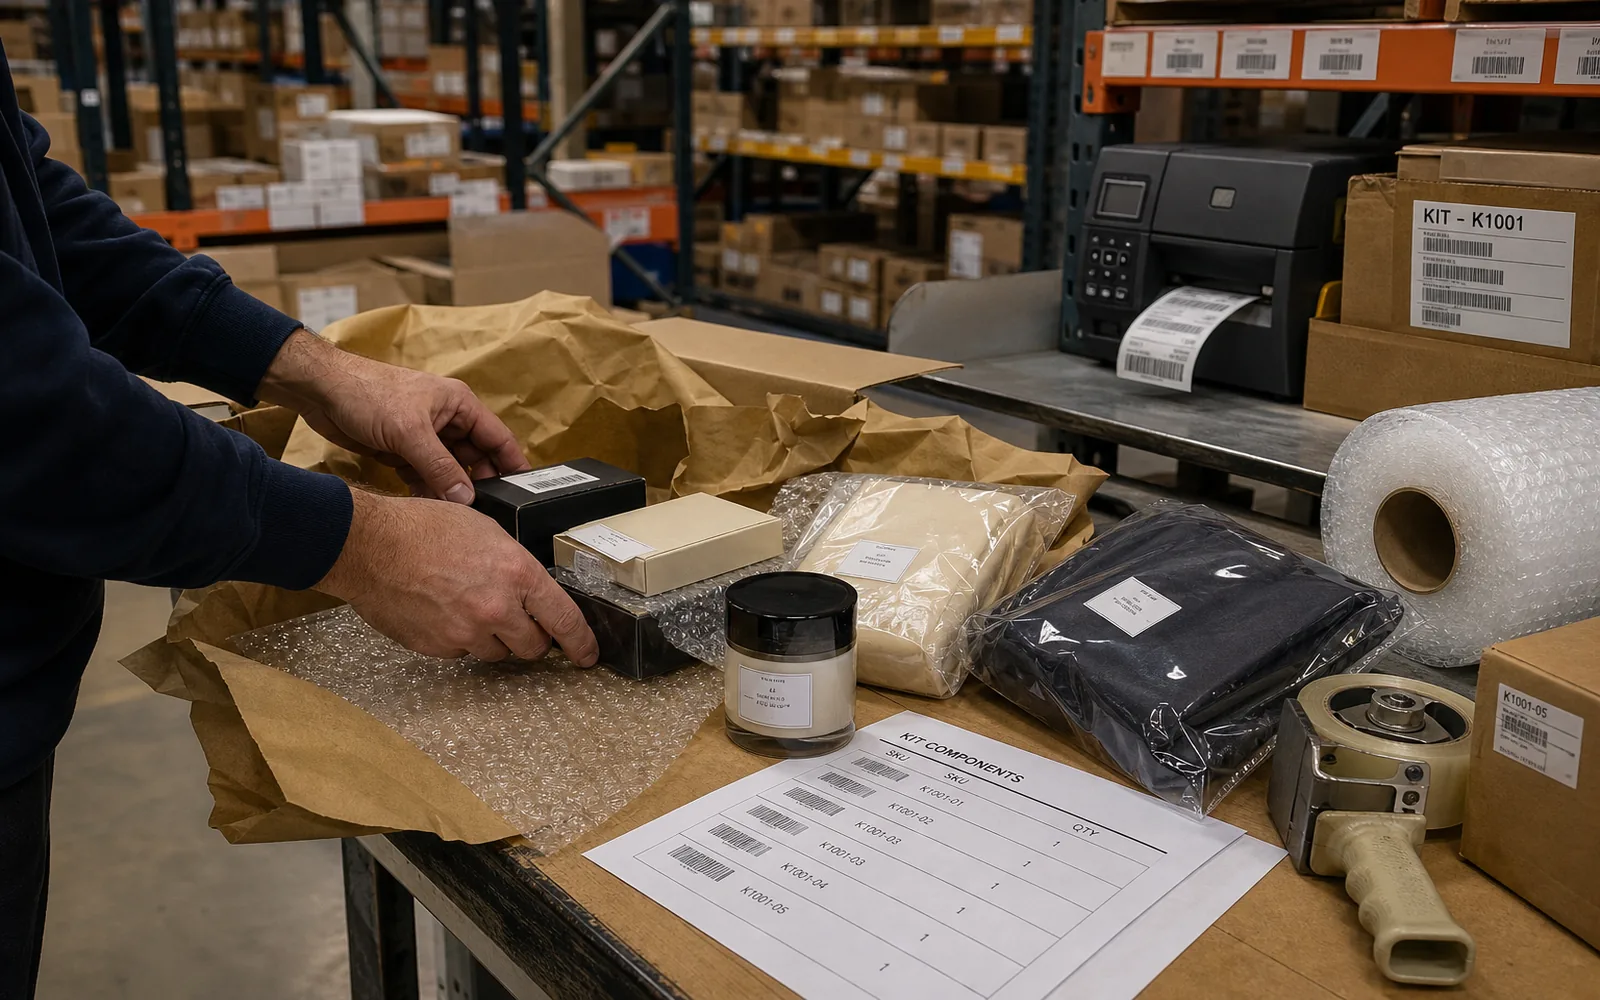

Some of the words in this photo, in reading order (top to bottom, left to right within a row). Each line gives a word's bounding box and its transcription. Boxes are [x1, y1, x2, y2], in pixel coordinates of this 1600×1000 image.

[1423, 208, 1451, 225] KIT
[1472, 211, 1523, 231] K1001
[1503, 690, 1548, 718] K1001-05
[900, 732, 926, 745] KIT
[924, 742, 1025, 784] COMPONENTS
[885, 750, 910, 762] SKU
[944, 773, 970, 785] SKU
[1072, 823, 1100, 837] QTY
[920, 785, 964, 807] K1001-01
[888, 802, 934, 825] K1001-02
[854, 820, 902, 845] K1001-03
[819, 841, 866, 867] K1001-03
[780, 862, 829, 890] K1001-04
[740, 885, 789, 915] K1001-05
